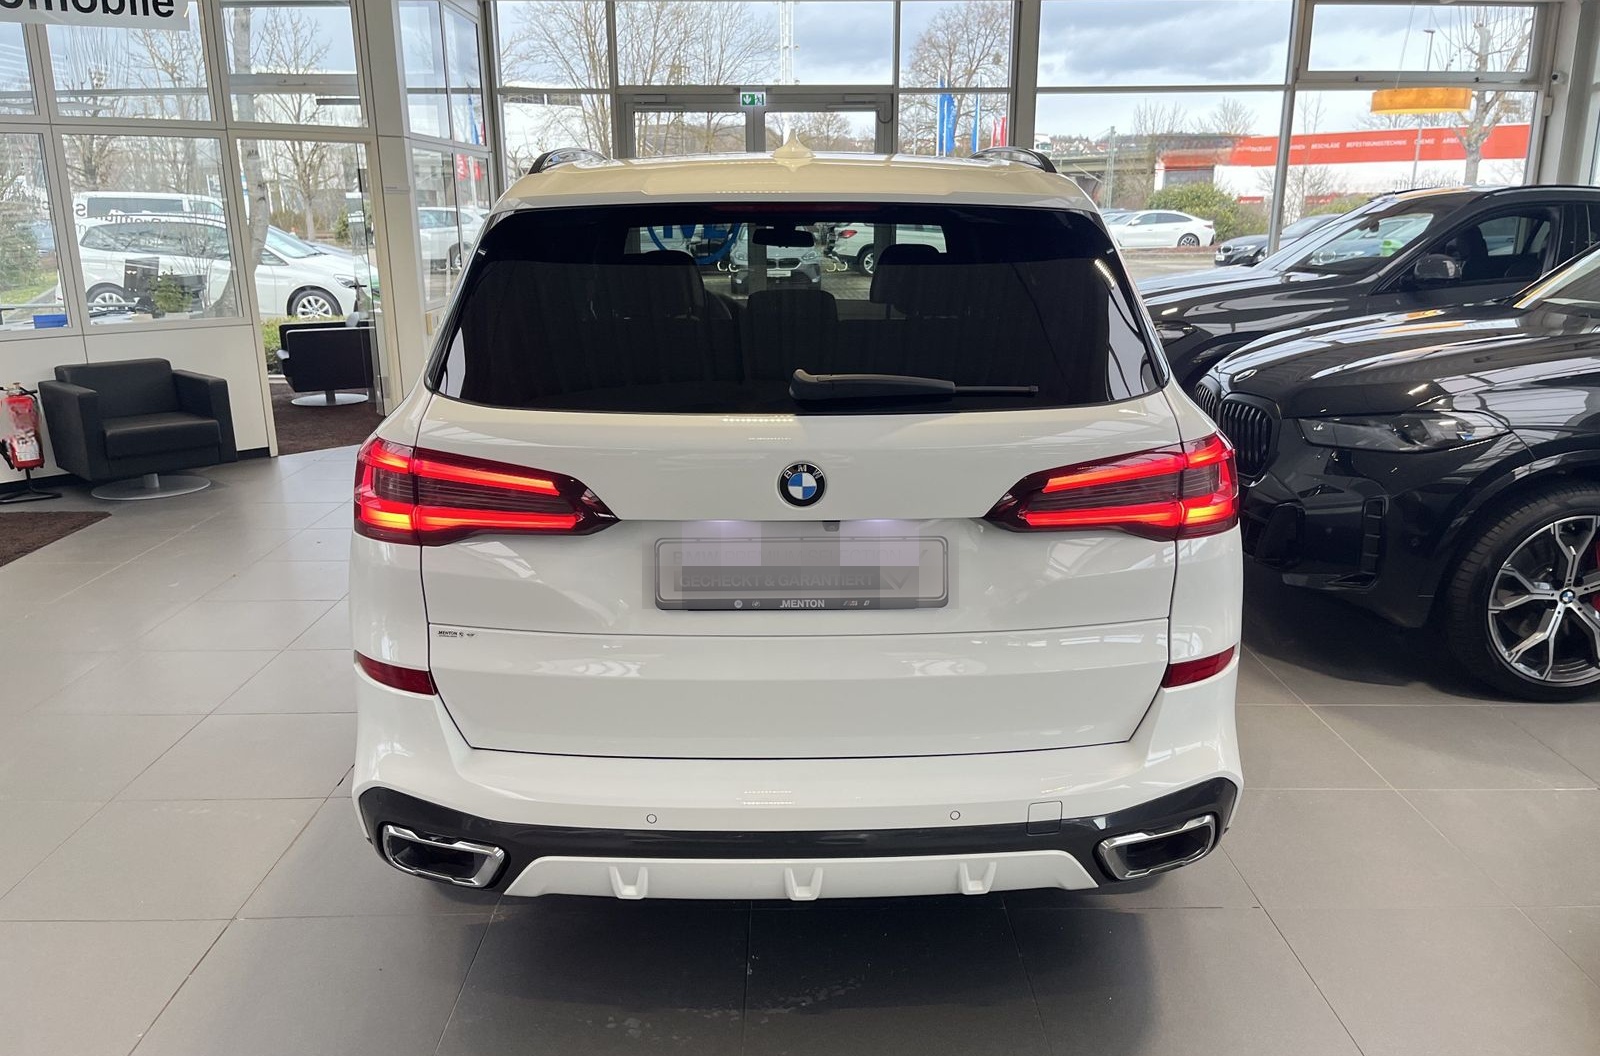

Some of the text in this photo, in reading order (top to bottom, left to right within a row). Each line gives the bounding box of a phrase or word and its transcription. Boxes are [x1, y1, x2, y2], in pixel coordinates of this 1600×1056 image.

[784, 464, 822, 480] BMW
[673, 551, 719, 564] BMW
[680, 573, 875, 588] GECHECKT & GARANTIERT
[780, 600, 825, 608] MENTON
